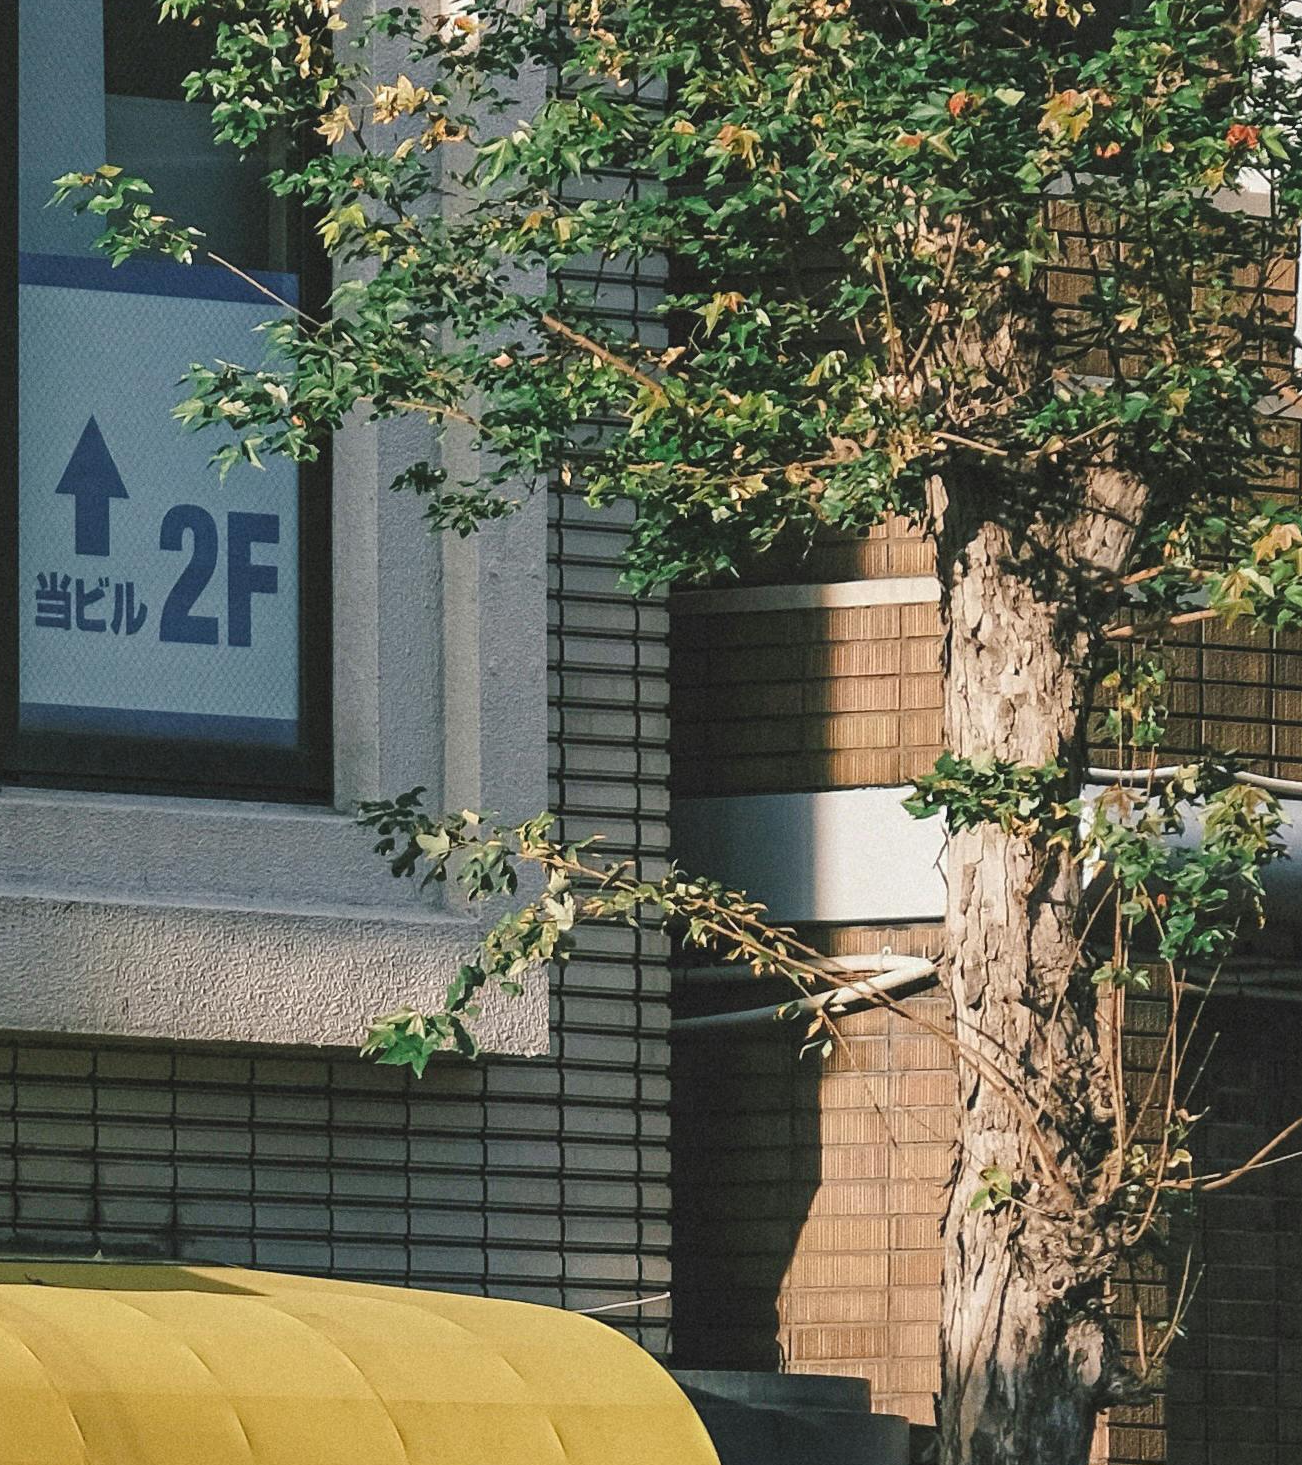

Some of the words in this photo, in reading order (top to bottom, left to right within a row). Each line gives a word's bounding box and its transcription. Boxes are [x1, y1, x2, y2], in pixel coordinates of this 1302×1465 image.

[33, 570, 148, 637] 当ビル
[158, 502, 280, 648] 2F
